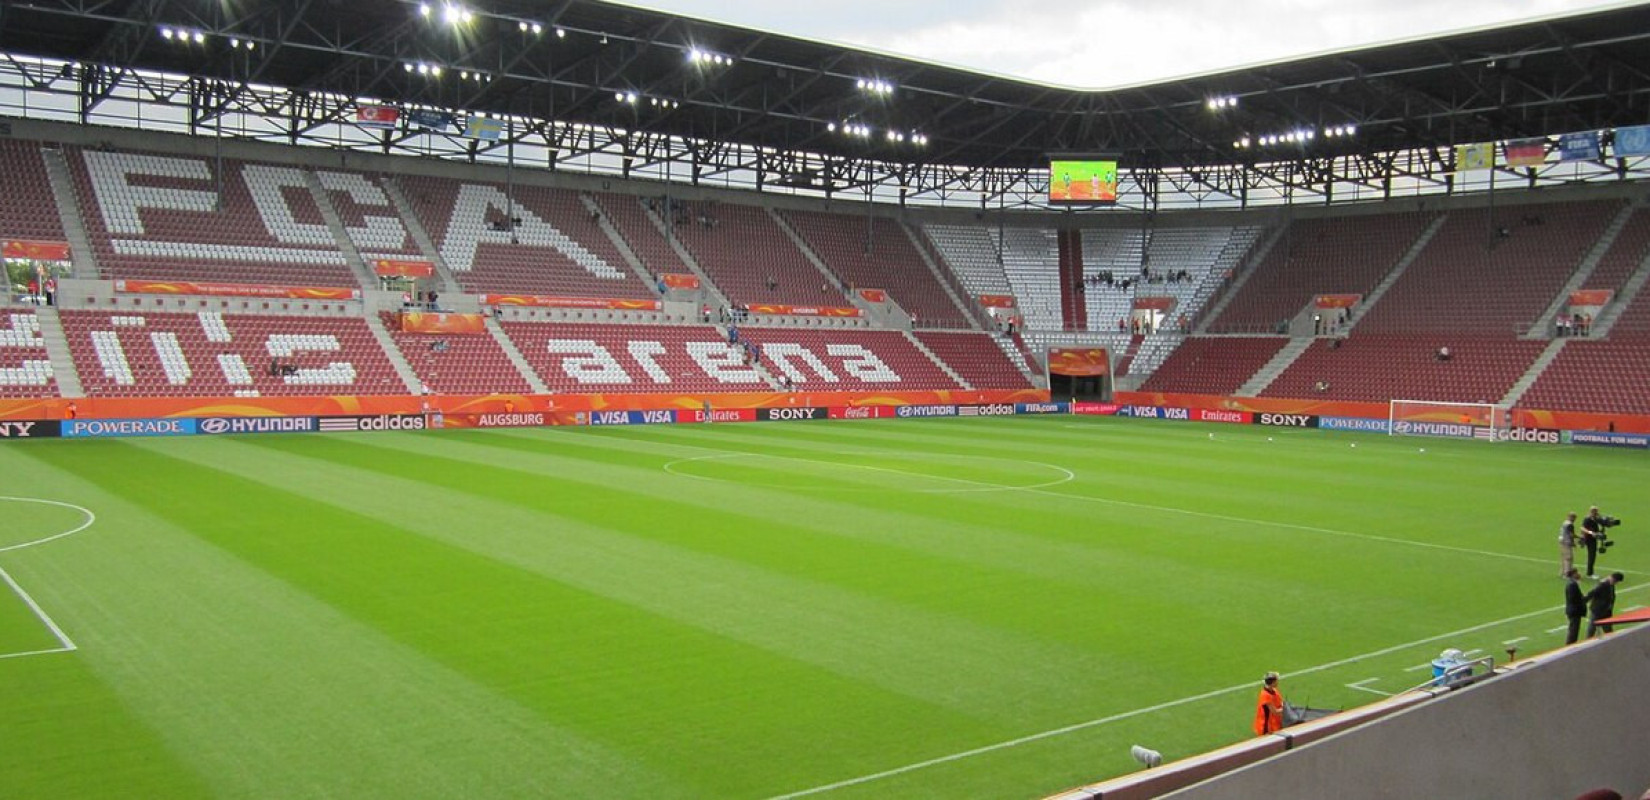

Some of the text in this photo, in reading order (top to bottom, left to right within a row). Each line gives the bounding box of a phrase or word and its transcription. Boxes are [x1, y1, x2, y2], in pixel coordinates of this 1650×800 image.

[547, 339, 901, 384] arena
[769, 408, 816, 419] SONY
[913, 405, 955, 415] HYUNDAI
[979, 404, 1013, 415] adidas
[1134, 406, 1157, 417] VISA
[1164, 408, 1188, 419] VISA
[1201, 410, 1241, 422] Emirates
[359, 415, 424, 430] adidas
[479, 413, 544, 426] AUGSBURG
[599, 411, 630, 424] VISA
[642, 410, 672, 423] VISA
[1260, 414, 1310, 427] SONY
[1321, 417, 1388, 430] POWERADE
[74, 420, 180, 434] POWERADE
[232, 418, 312, 431] HYUNDAI
[1413, 423, 1472, 436] HYUNDAI
[1498, 427, 1559, 443] adidas
[1573, 434, 1609, 443] FOOTBALL
